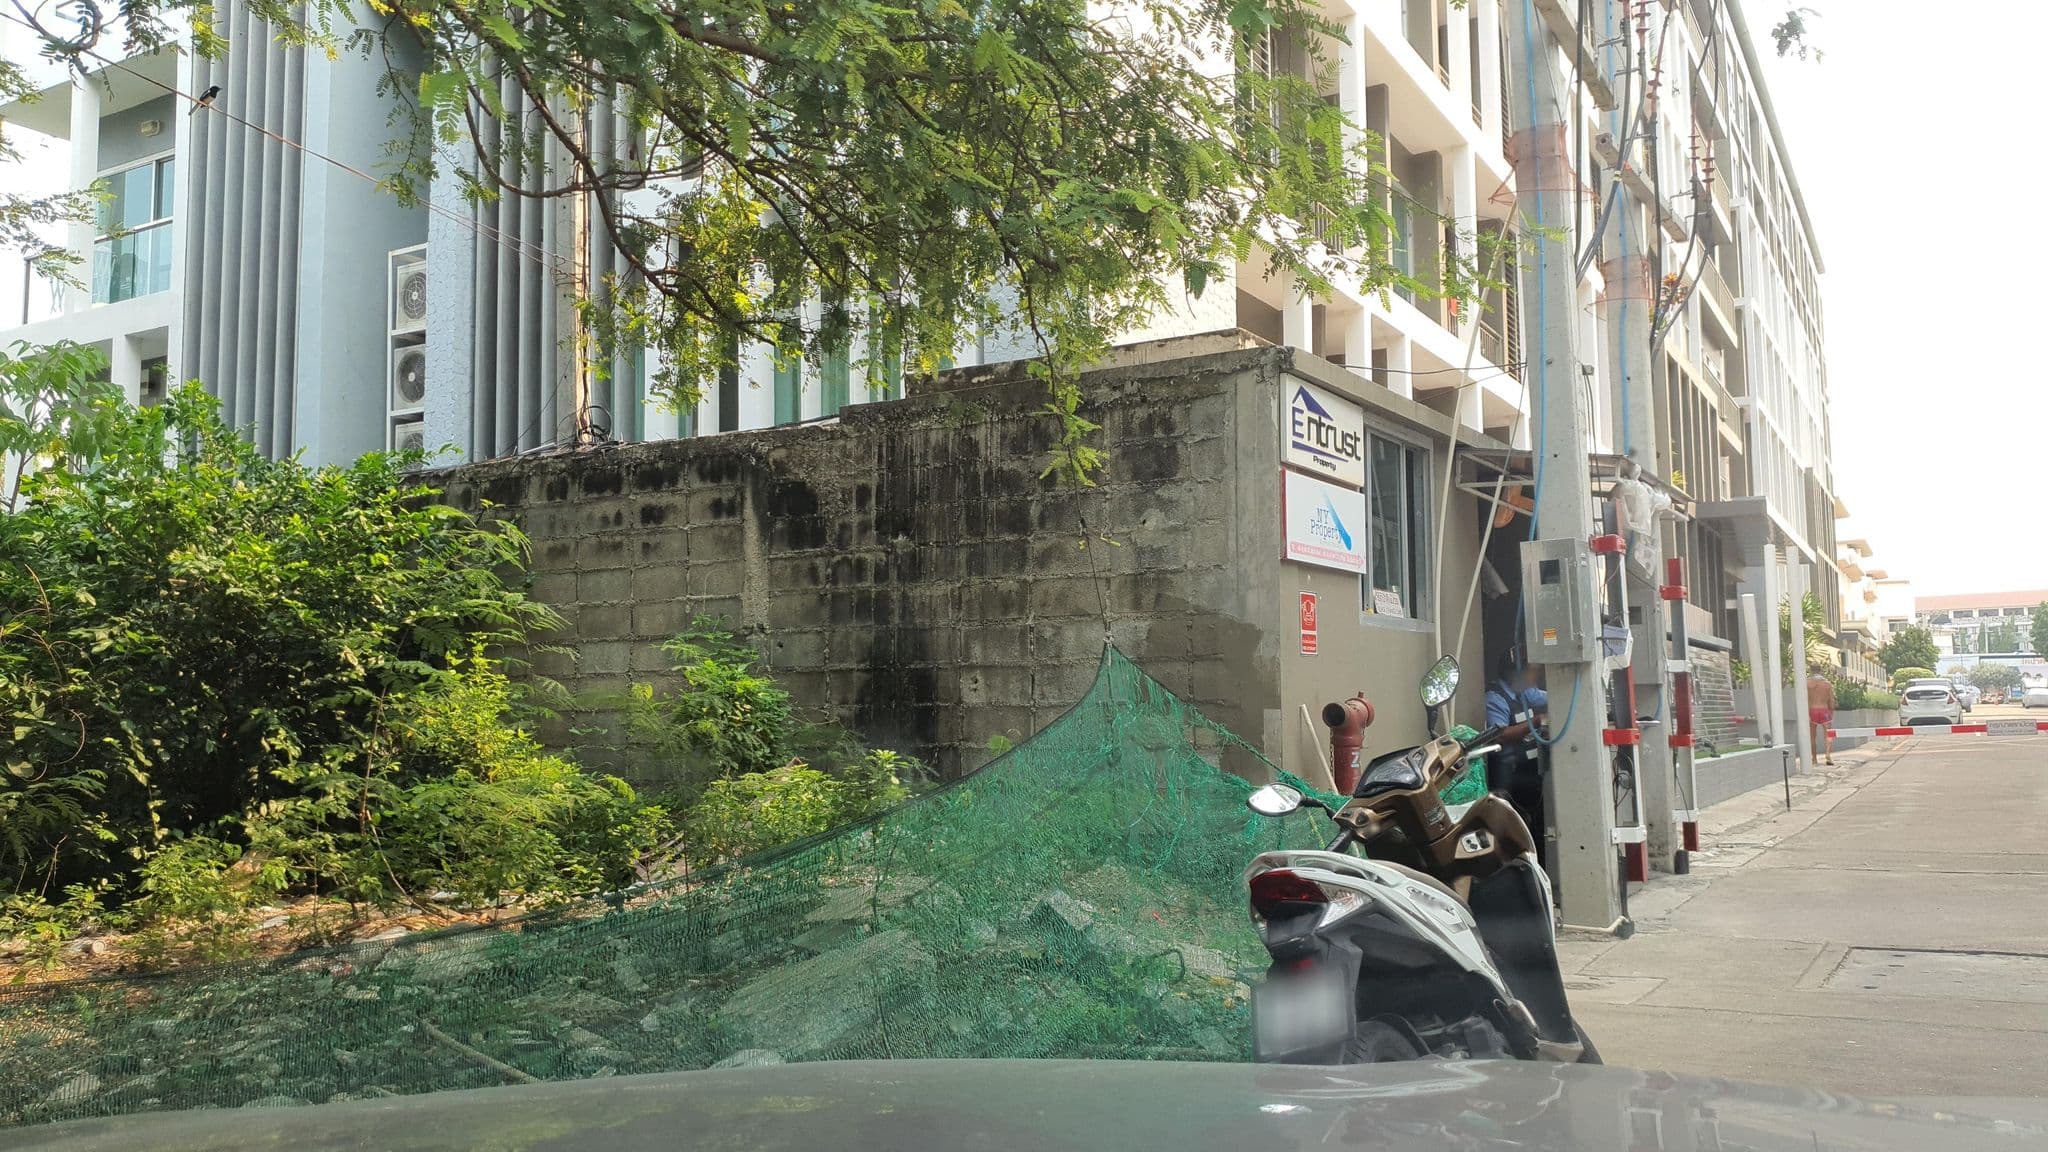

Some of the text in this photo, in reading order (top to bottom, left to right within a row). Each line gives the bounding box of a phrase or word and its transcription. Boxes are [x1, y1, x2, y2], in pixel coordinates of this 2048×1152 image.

[1292, 406, 1361, 461] Entrust
[1313, 455, 1336, 471] Property
[1310, 519, 1342, 544] Property
